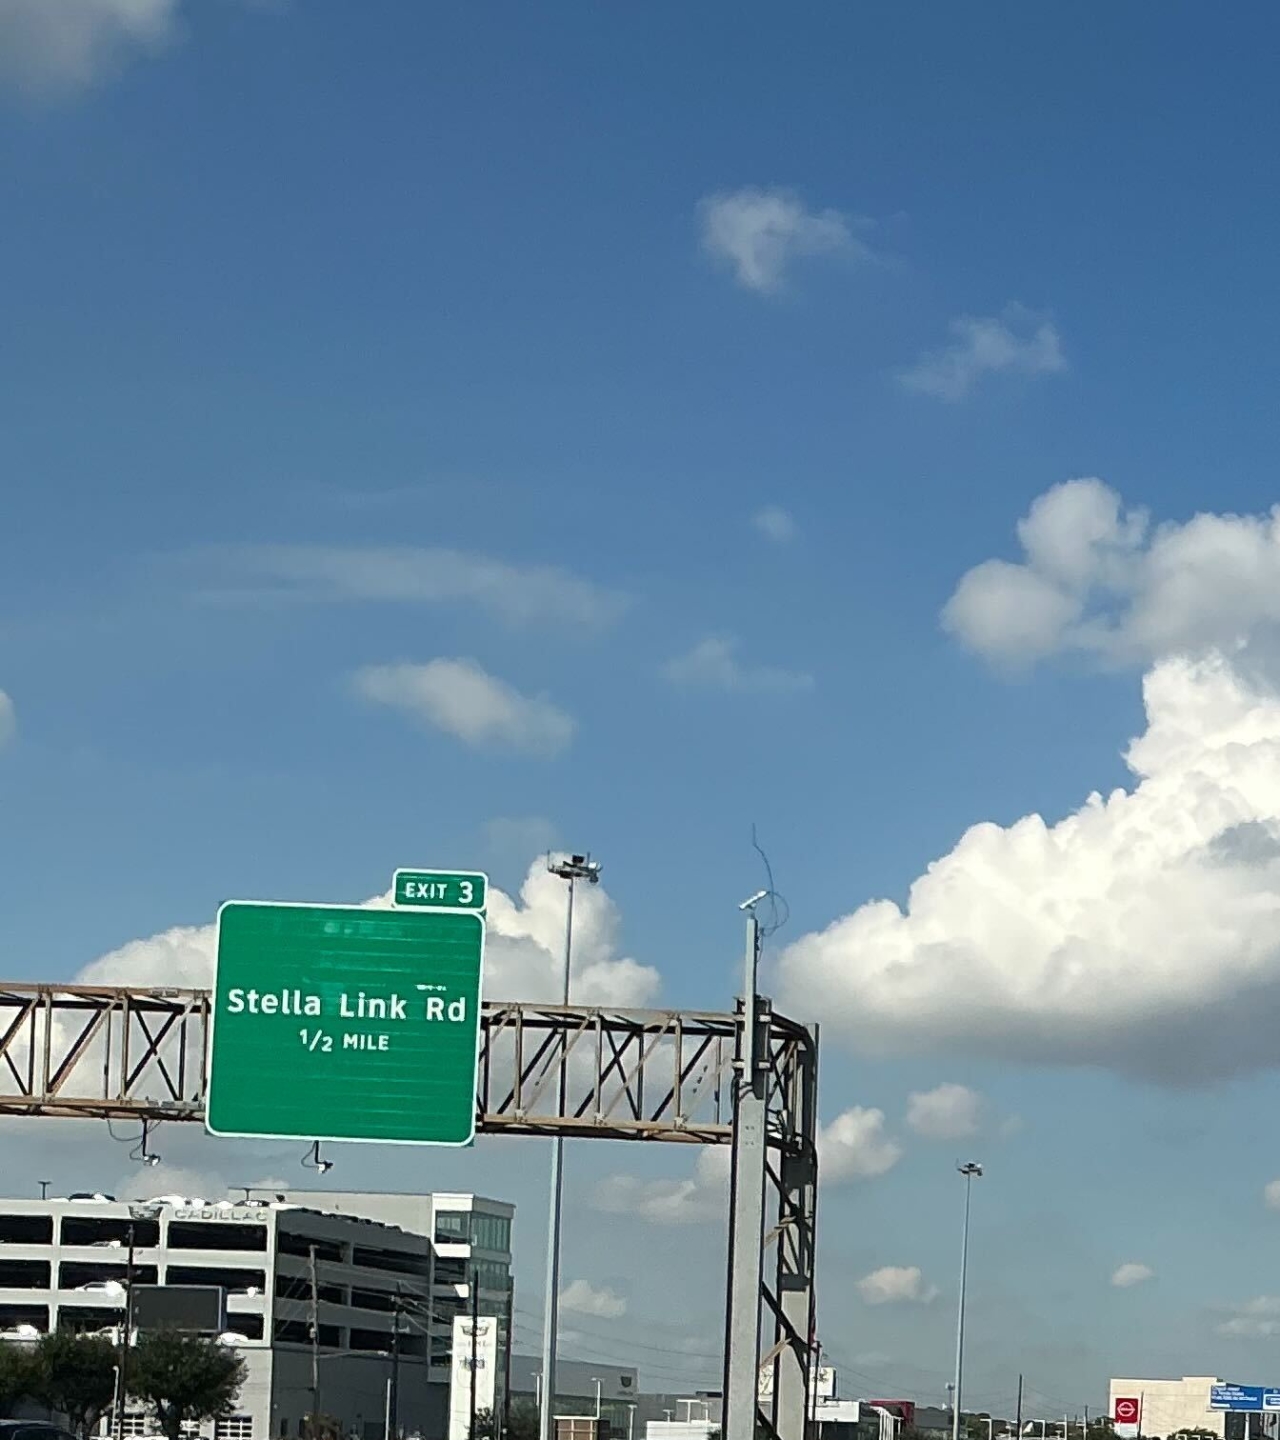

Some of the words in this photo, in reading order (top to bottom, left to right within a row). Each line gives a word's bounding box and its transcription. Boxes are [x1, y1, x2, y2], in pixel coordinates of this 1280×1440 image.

[405, 881, 448, 900] EXIT
[458, 881, 474, 904] 3
[227, 988, 322, 1015] Stella
[339, 991, 407, 1020] Link
[425, 996, 467, 1023] Rd
[342, 1033, 390, 1051] MILE
[174, 1208, 268, 1222] CADILLAC
